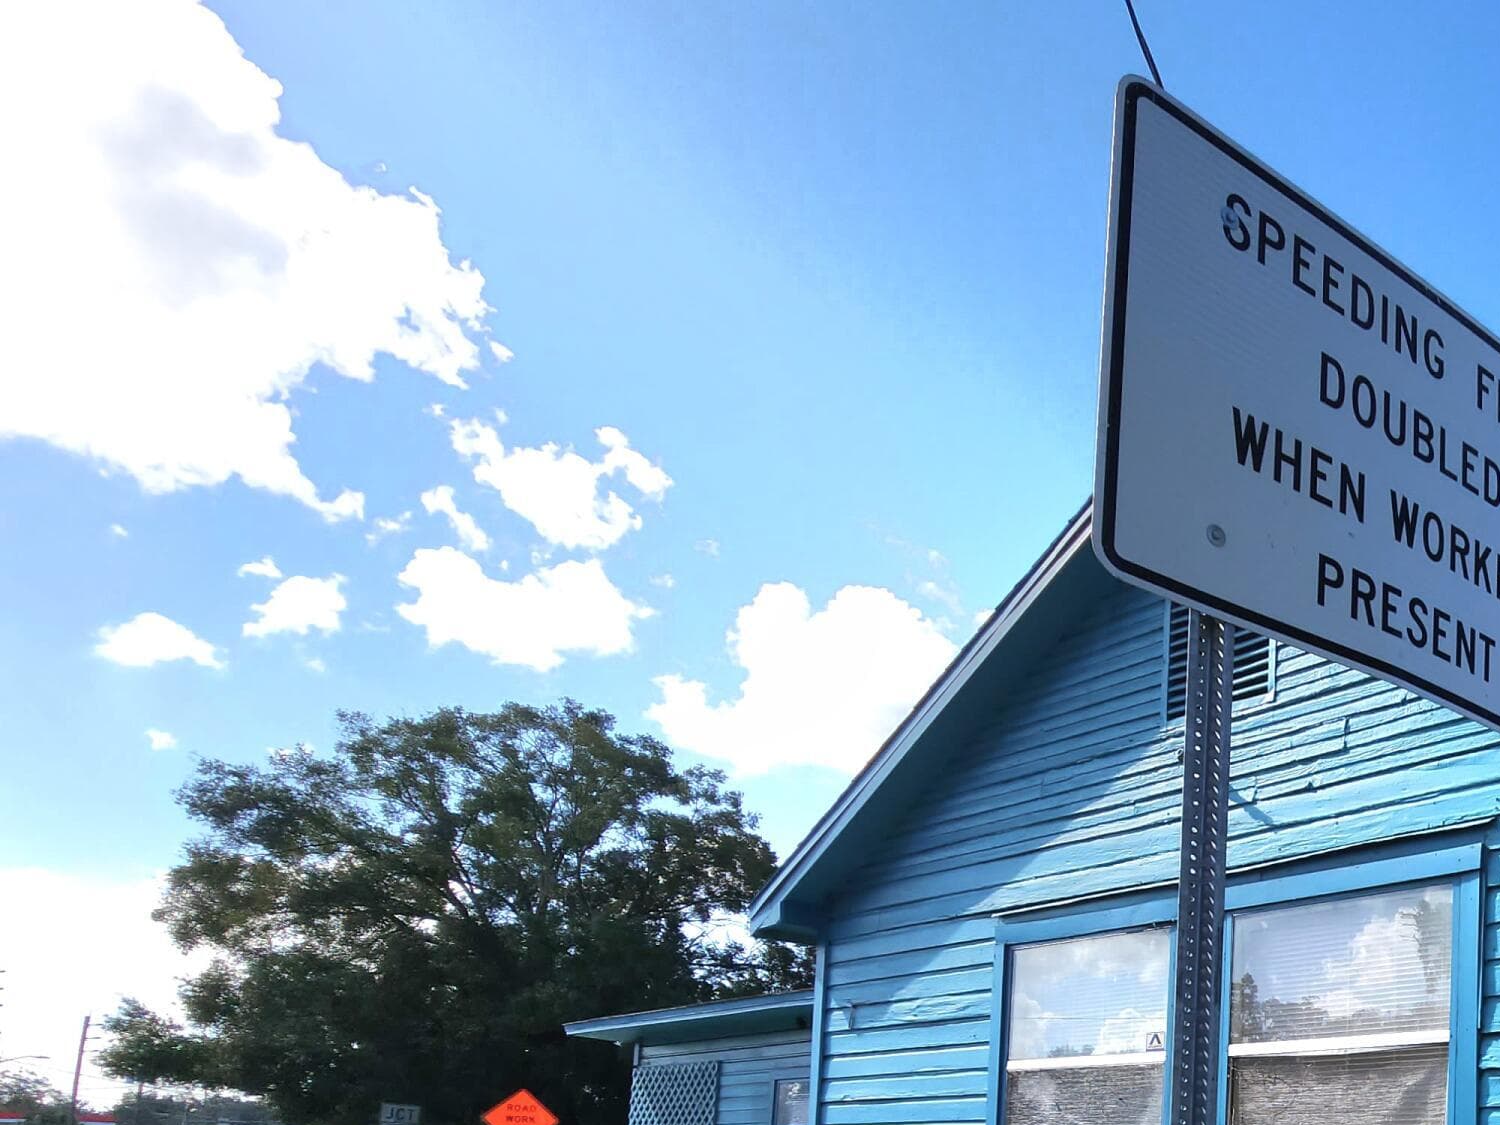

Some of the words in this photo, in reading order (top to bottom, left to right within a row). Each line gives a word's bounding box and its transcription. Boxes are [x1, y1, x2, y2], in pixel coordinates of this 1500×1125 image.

[1223, 193, 1445, 380] SPEEDING
[1231, 405, 1366, 524] WHEN
[1317, 552, 1496, 683] PRESENT
[386, 1107, 415, 1120] JCT
[505, 1115, 536, 1124] WORK
[507, 1103, 537, 1113] ROAD
